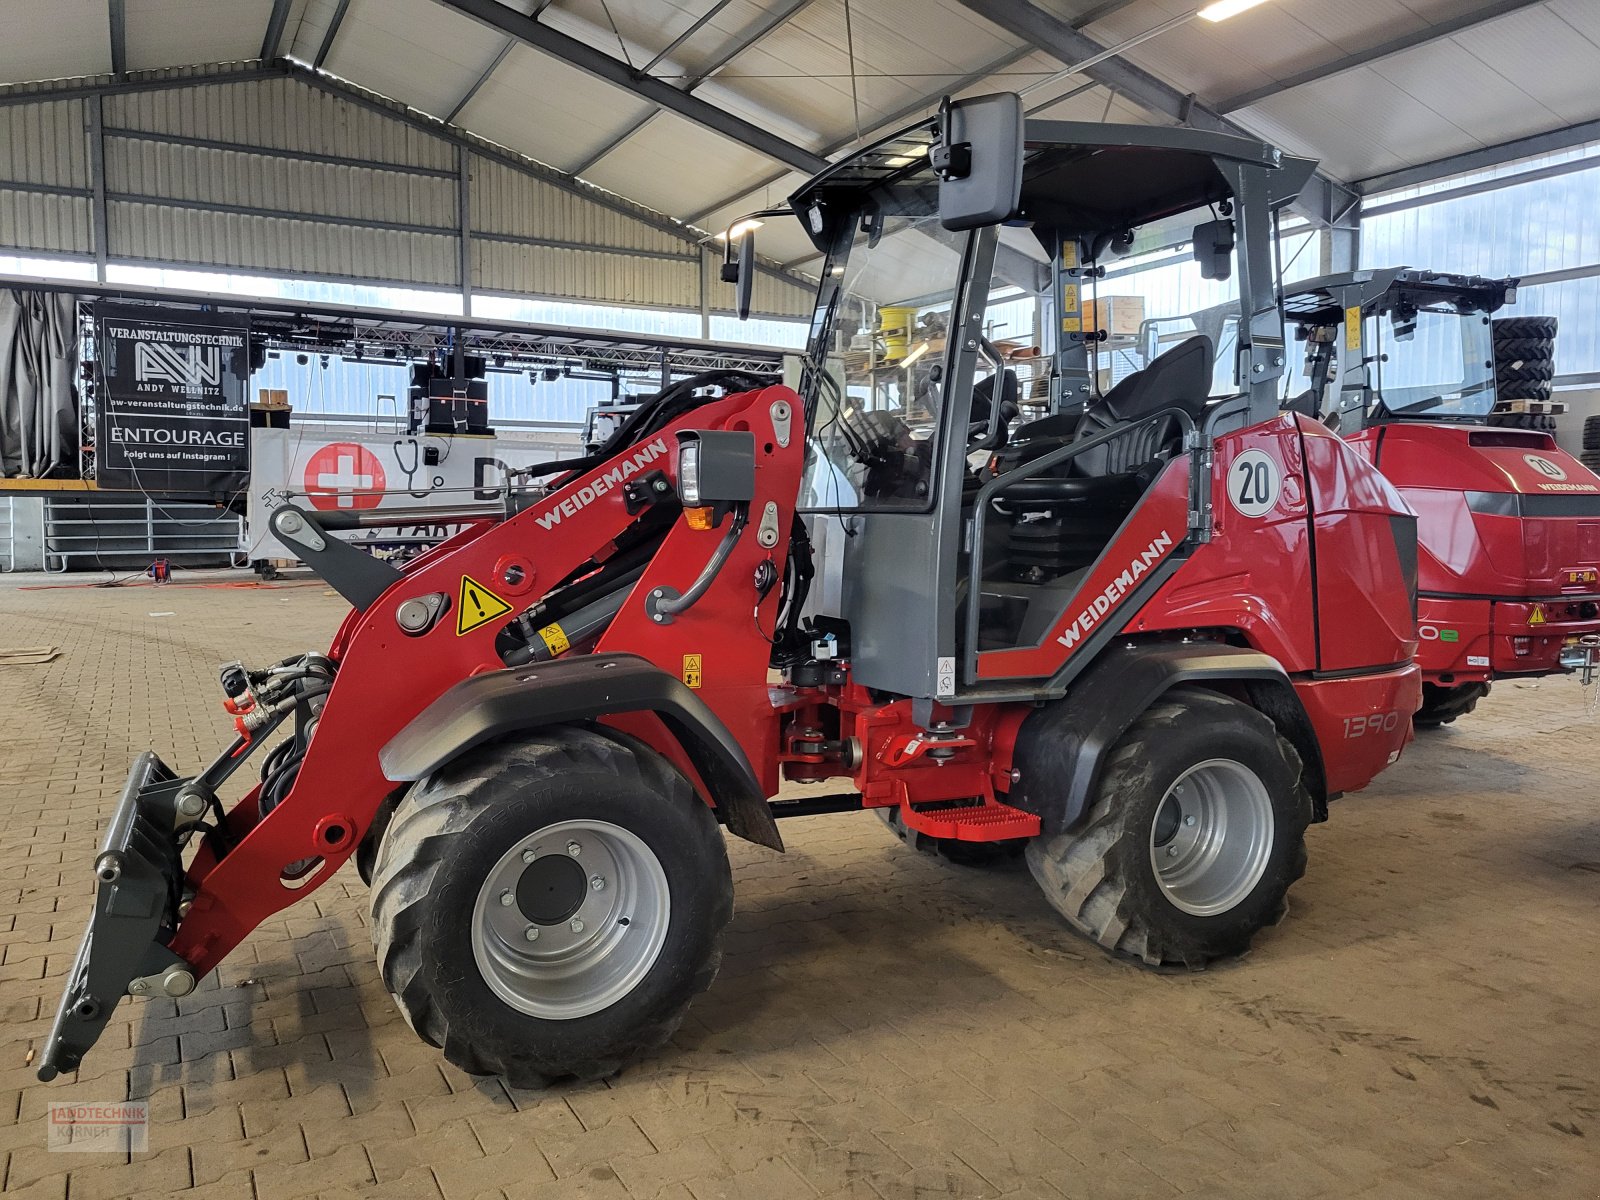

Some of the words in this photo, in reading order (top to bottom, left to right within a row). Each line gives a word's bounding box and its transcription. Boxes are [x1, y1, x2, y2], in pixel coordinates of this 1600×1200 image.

[109, 327, 243, 347] VERANSTALTUNGSTECHNIK
[137, 383, 164, 392] ANDY
[171, 385, 220, 395] WELLNITZ
[111, 427, 245, 446] ENTOURAGE
[124, 450, 147, 459] Folgt
[182, 452, 225, 461] Instagram
[535, 438, 669, 531] WEIDEMANN
[1239, 461, 1269, 504] 20
[1056, 530, 1172, 649] WEIDEMANN
[1343, 711, 1399, 739] 1390
